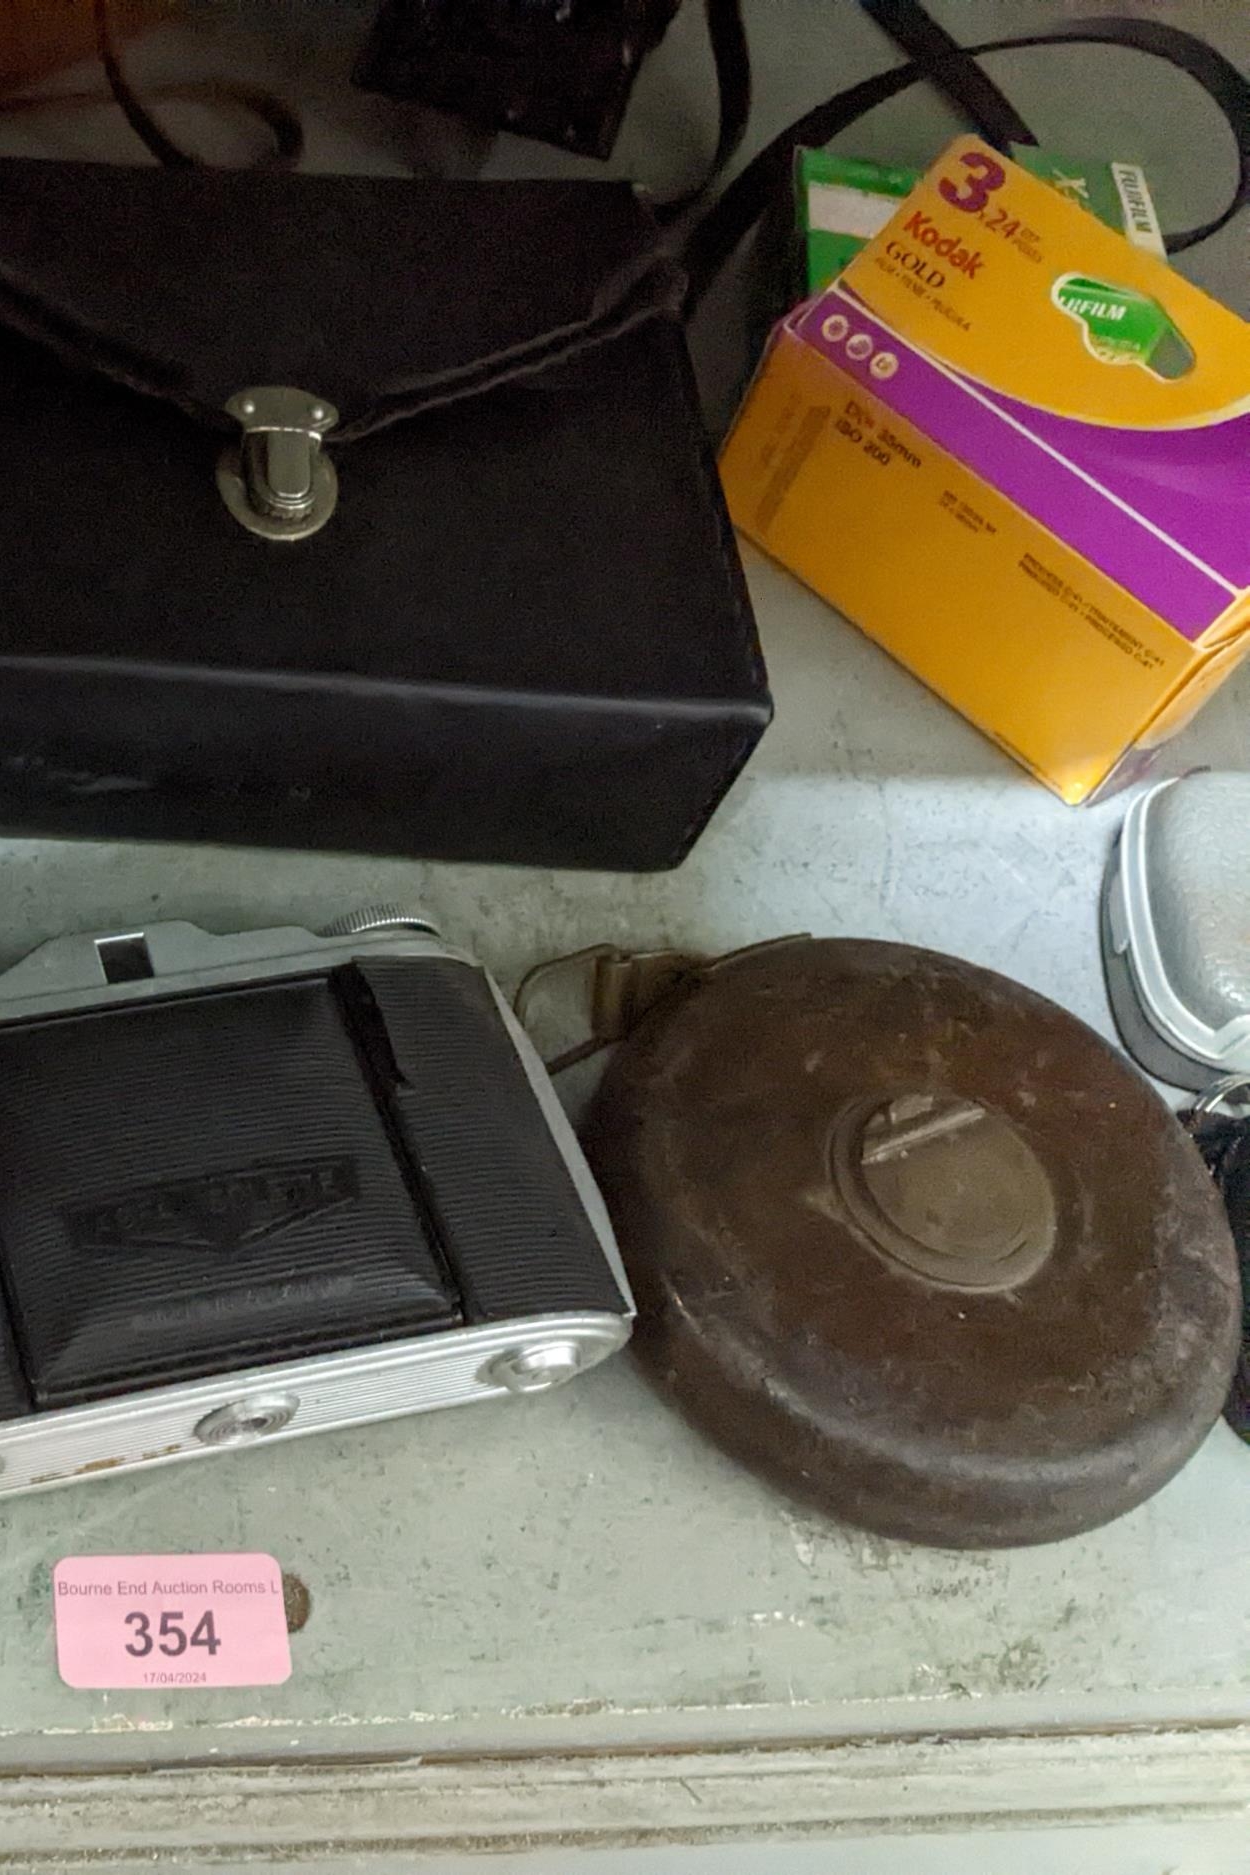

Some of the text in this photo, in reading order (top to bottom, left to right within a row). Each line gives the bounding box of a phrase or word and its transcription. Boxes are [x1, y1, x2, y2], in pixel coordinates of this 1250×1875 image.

[938, 152, 1005, 214] 3
[985, 211, 1021, 239] 24
[1117, 168, 1153, 234] FUJIFILM
[884, 239, 946, 290] GOLD
[902, 210, 986, 280] Kodak
[58, 1579, 279, 1596] Bourne End Auction Rooms L
[124, 1609, 222, 1657] 354
[143, 1672, 207, 1684] 17/04/2024
